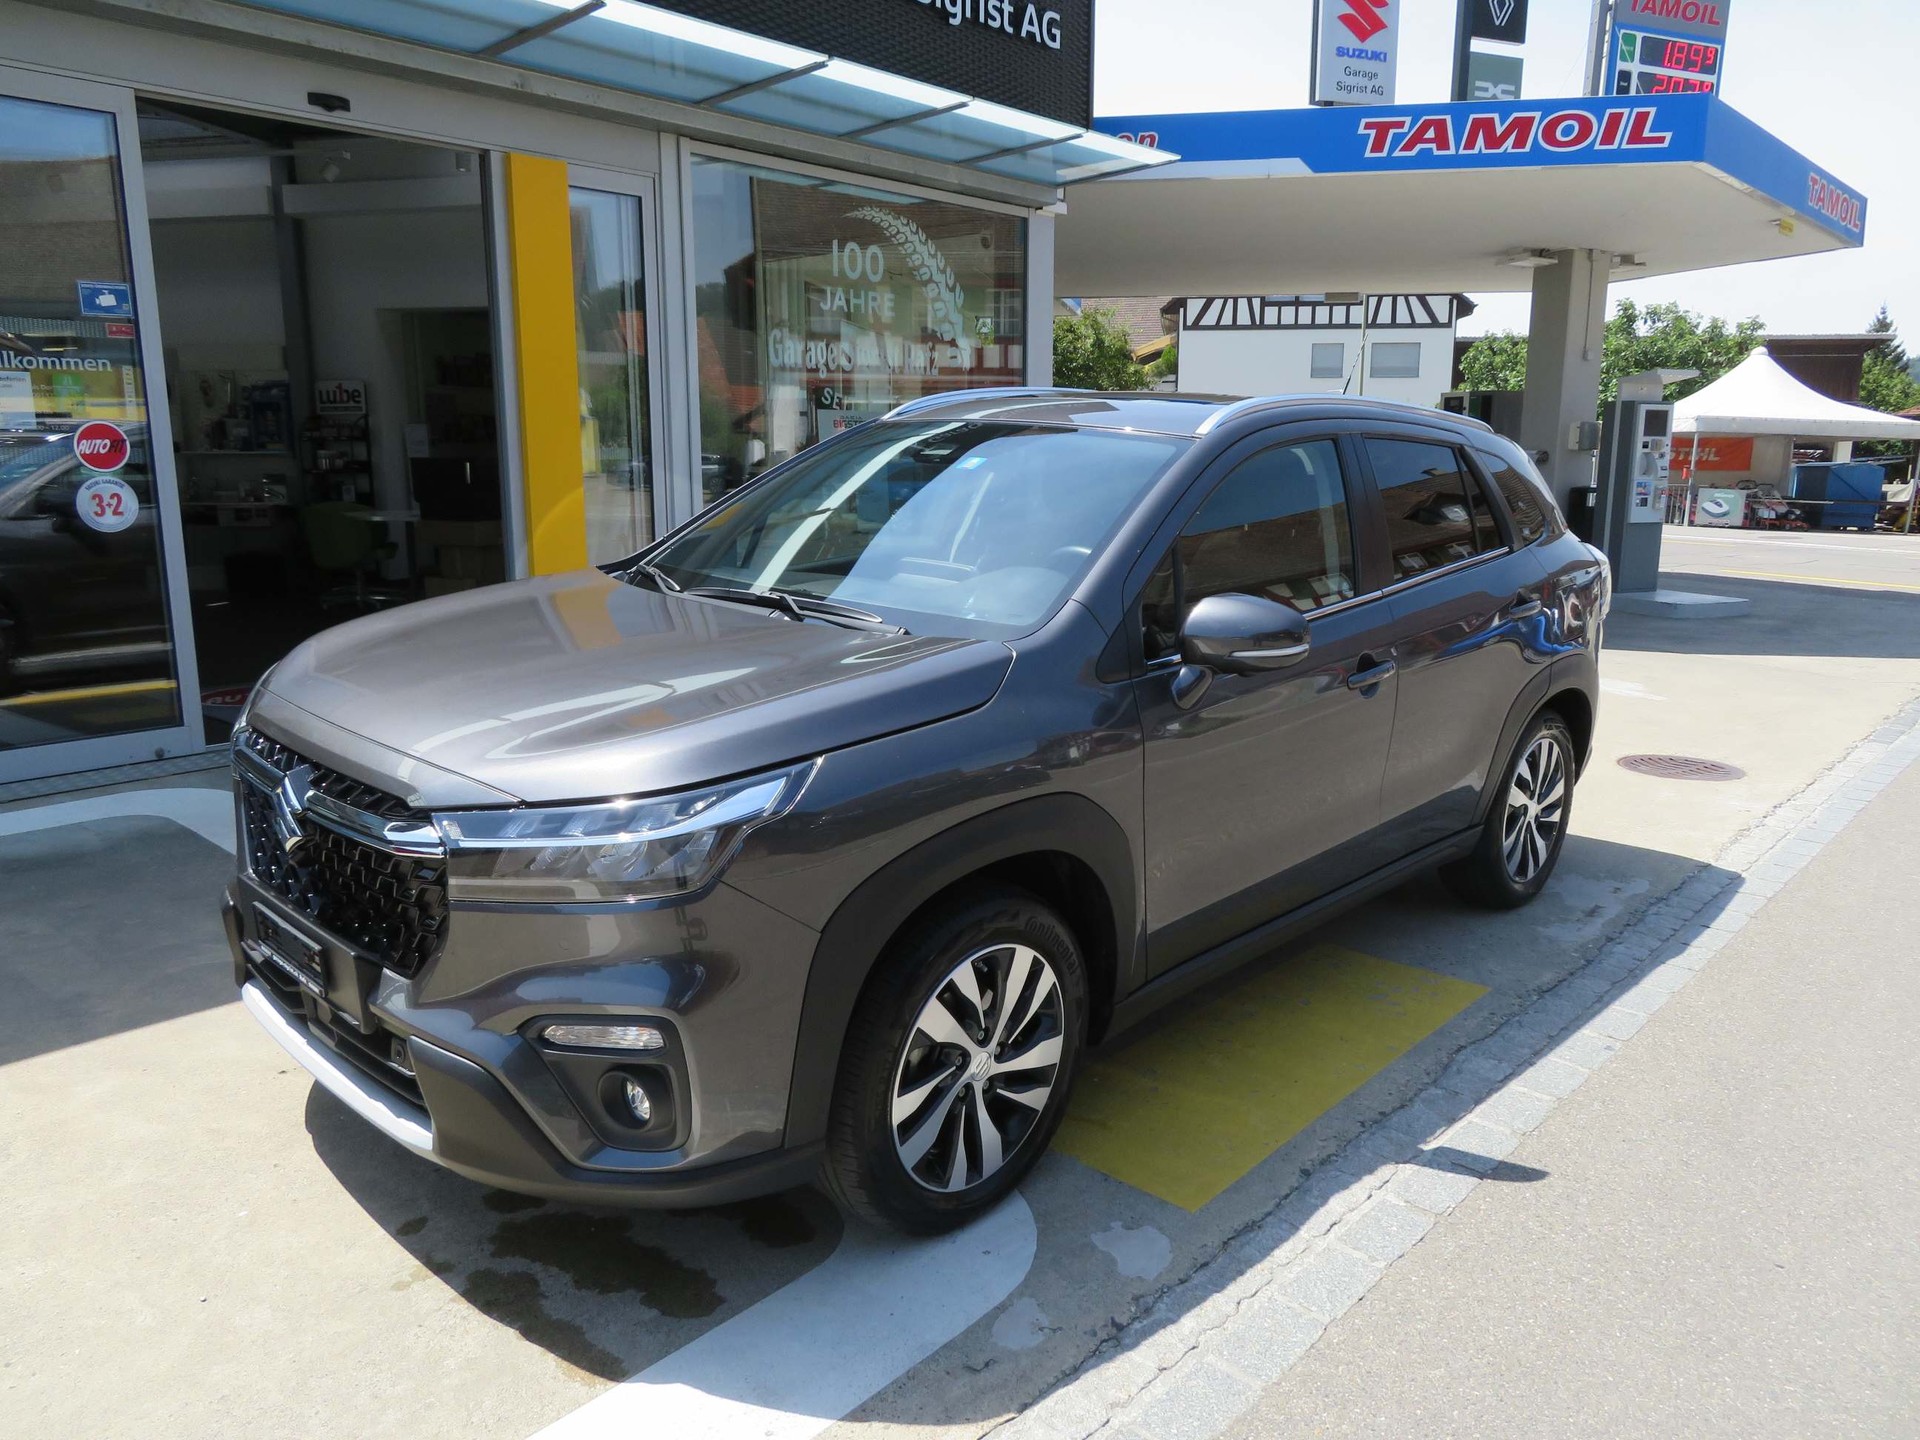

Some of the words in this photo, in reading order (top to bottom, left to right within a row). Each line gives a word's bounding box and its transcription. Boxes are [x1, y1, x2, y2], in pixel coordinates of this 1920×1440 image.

[1020, 3, 1061, 49] AG
[1335, 46, 1388, 63] SUZUKI
[1344, 66, 1379, 81] Garage
[1335, 80, 1368, 94] Sigrist
[1370, 84, 1384, 96] AG
[1359, 108, 1672, 157] TAMOIL
[1809, 173, 1860, 232] TAMOIL
[831, 239, 886, 283] 100
[820, 287, 896, 317] JAHRE
[769, 329, 837, 379] Garage
[91, 492, 125, 517] 3+2
[1024, 915, 1079, 976] Continental
